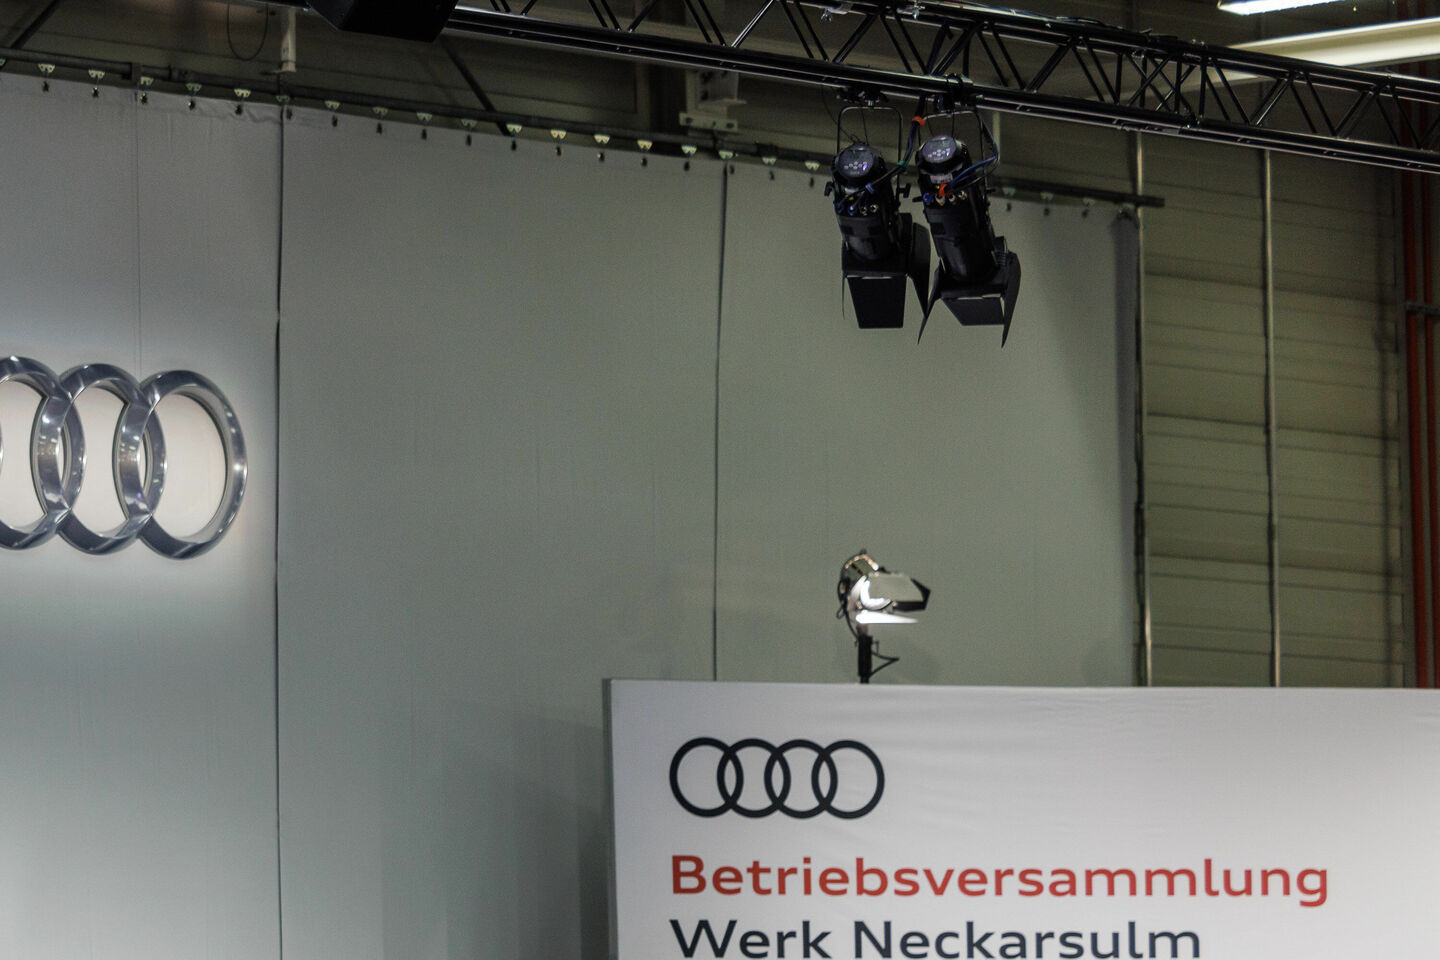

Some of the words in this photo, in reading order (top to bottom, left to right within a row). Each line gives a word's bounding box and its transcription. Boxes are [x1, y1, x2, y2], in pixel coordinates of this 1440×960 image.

[671, 854, 1328, 908] Betriebsversammlung
[669, 918, 832, 960] Werk
[853, 920, 1201, 960] Neckarsulm
